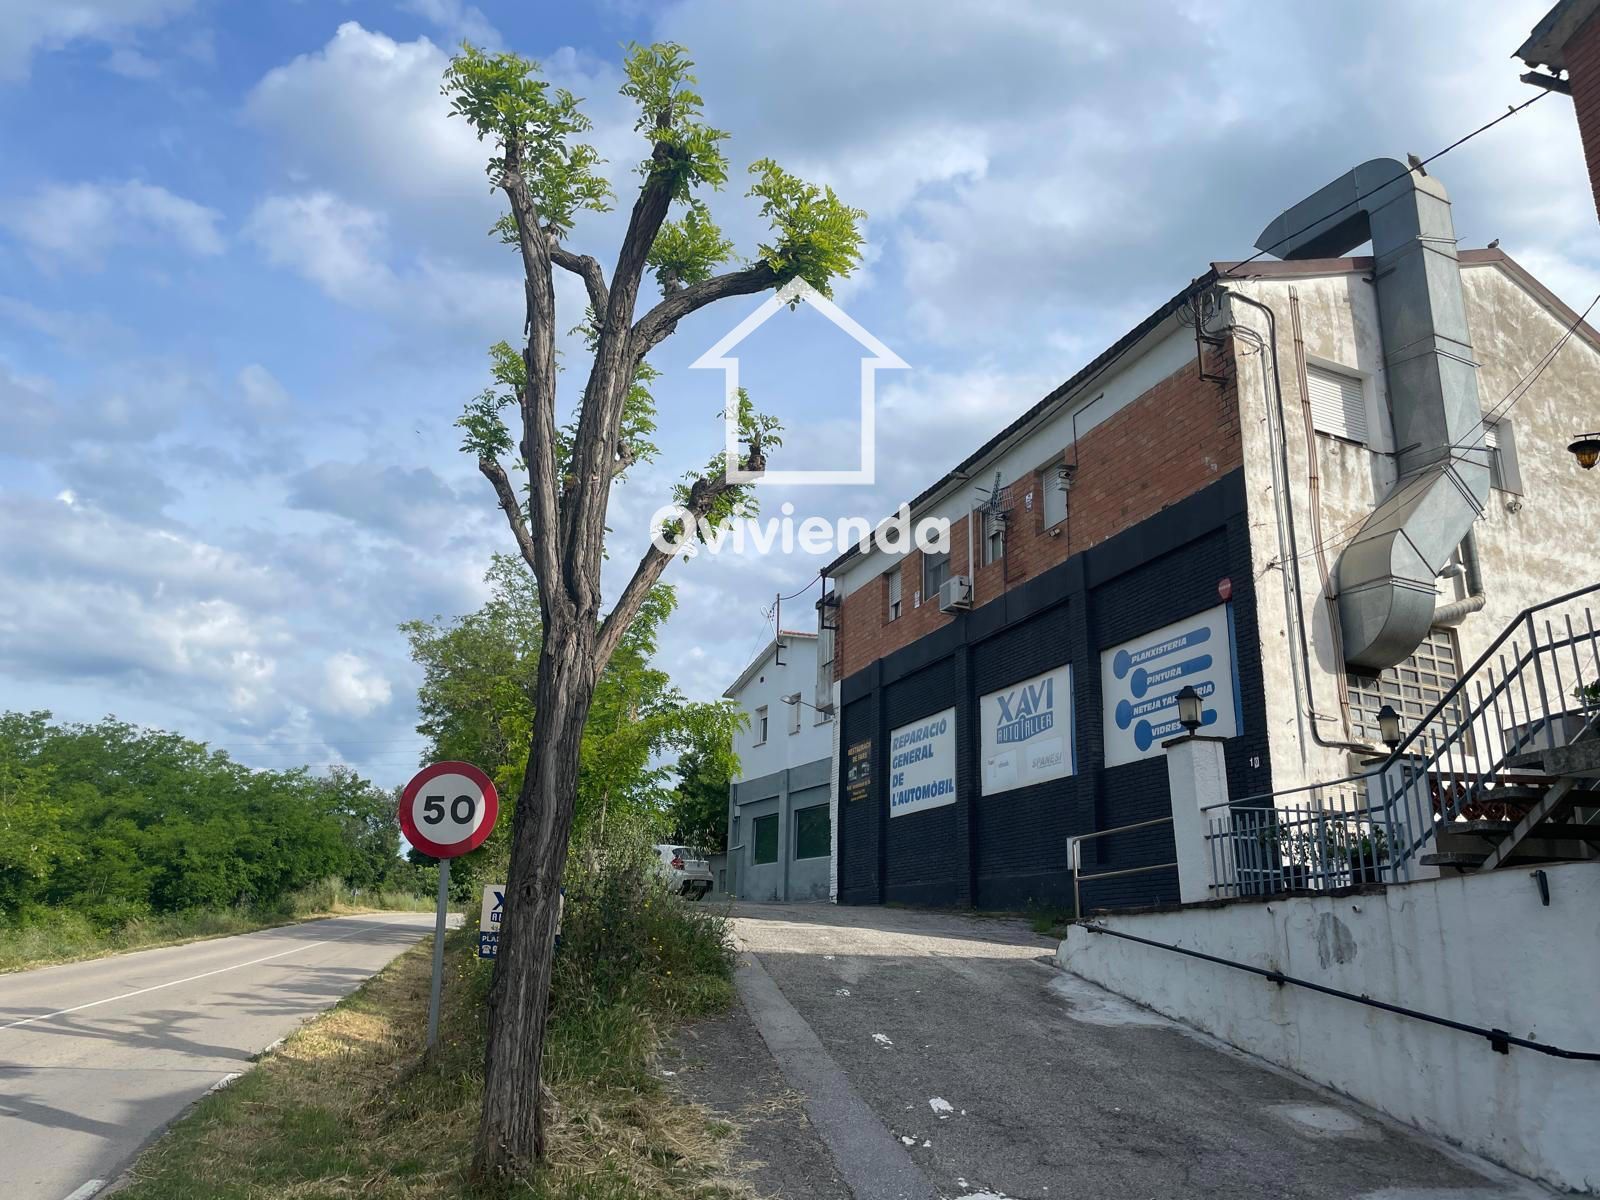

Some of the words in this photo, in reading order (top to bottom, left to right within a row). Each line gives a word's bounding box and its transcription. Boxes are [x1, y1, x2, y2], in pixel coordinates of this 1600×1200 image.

[1131, 637, 1187, 664] PLANXISTERIA
[1146, 667, 1182, 685] PINTURA
[997, 677, 1053, 726] XAVI
[1133, 700, 1161, 715] NETEJA
[892, 718, 947, 752] REPARACIÓ
[998, 713, 1053, 743] AUTOTALLER
[1151, 721, 1182, 737] VIDRES
[892, 744, 934, 769] GENERAL
[892, 772, 904, 788] DE
[892, 778, 954, 807] L'AUTOMÒBIL
[423, 795, 476, 825] 50
